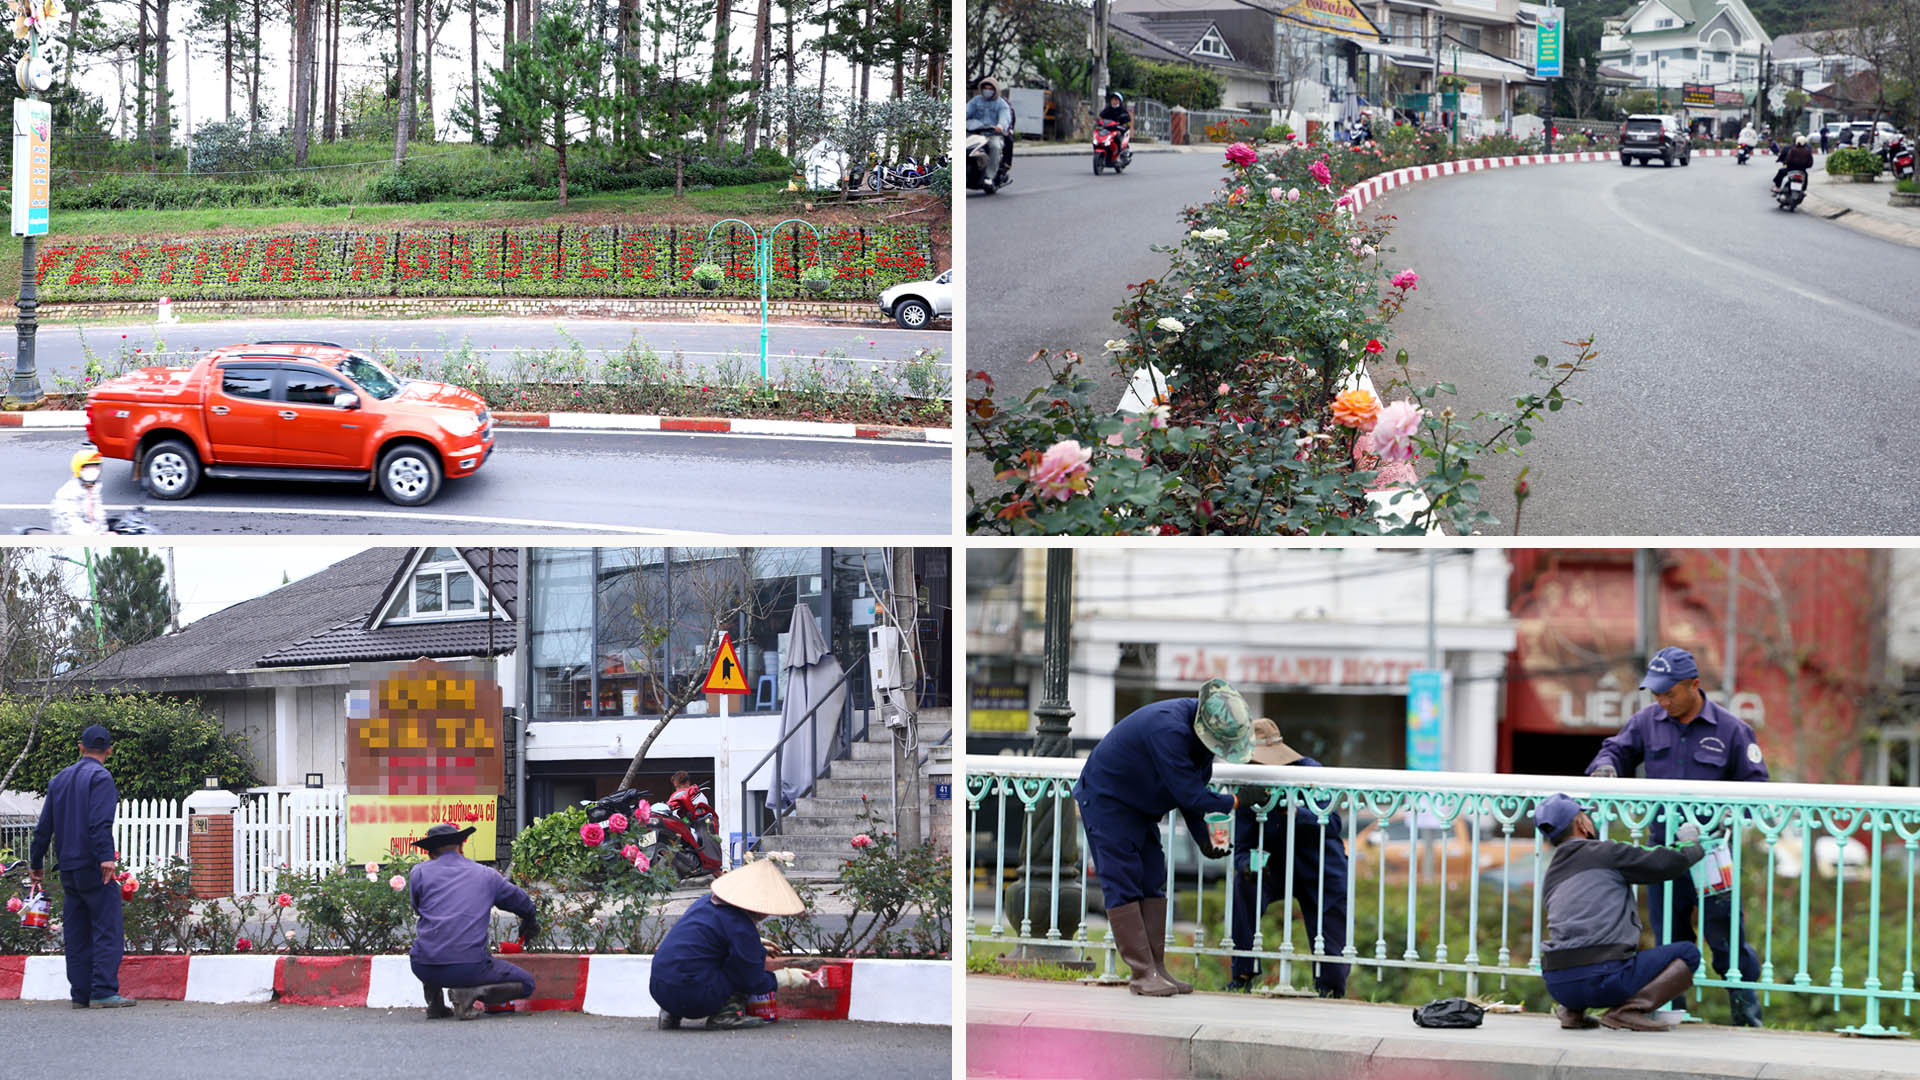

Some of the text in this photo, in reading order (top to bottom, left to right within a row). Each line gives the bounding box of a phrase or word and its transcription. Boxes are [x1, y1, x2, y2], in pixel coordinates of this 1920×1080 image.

[35, 237, 331, 285] FESTIVAL
[725, 231, 926, 279] 2024
[1239, 656, 1333, 684] THANH
[939, 785, 948, 793] 41
